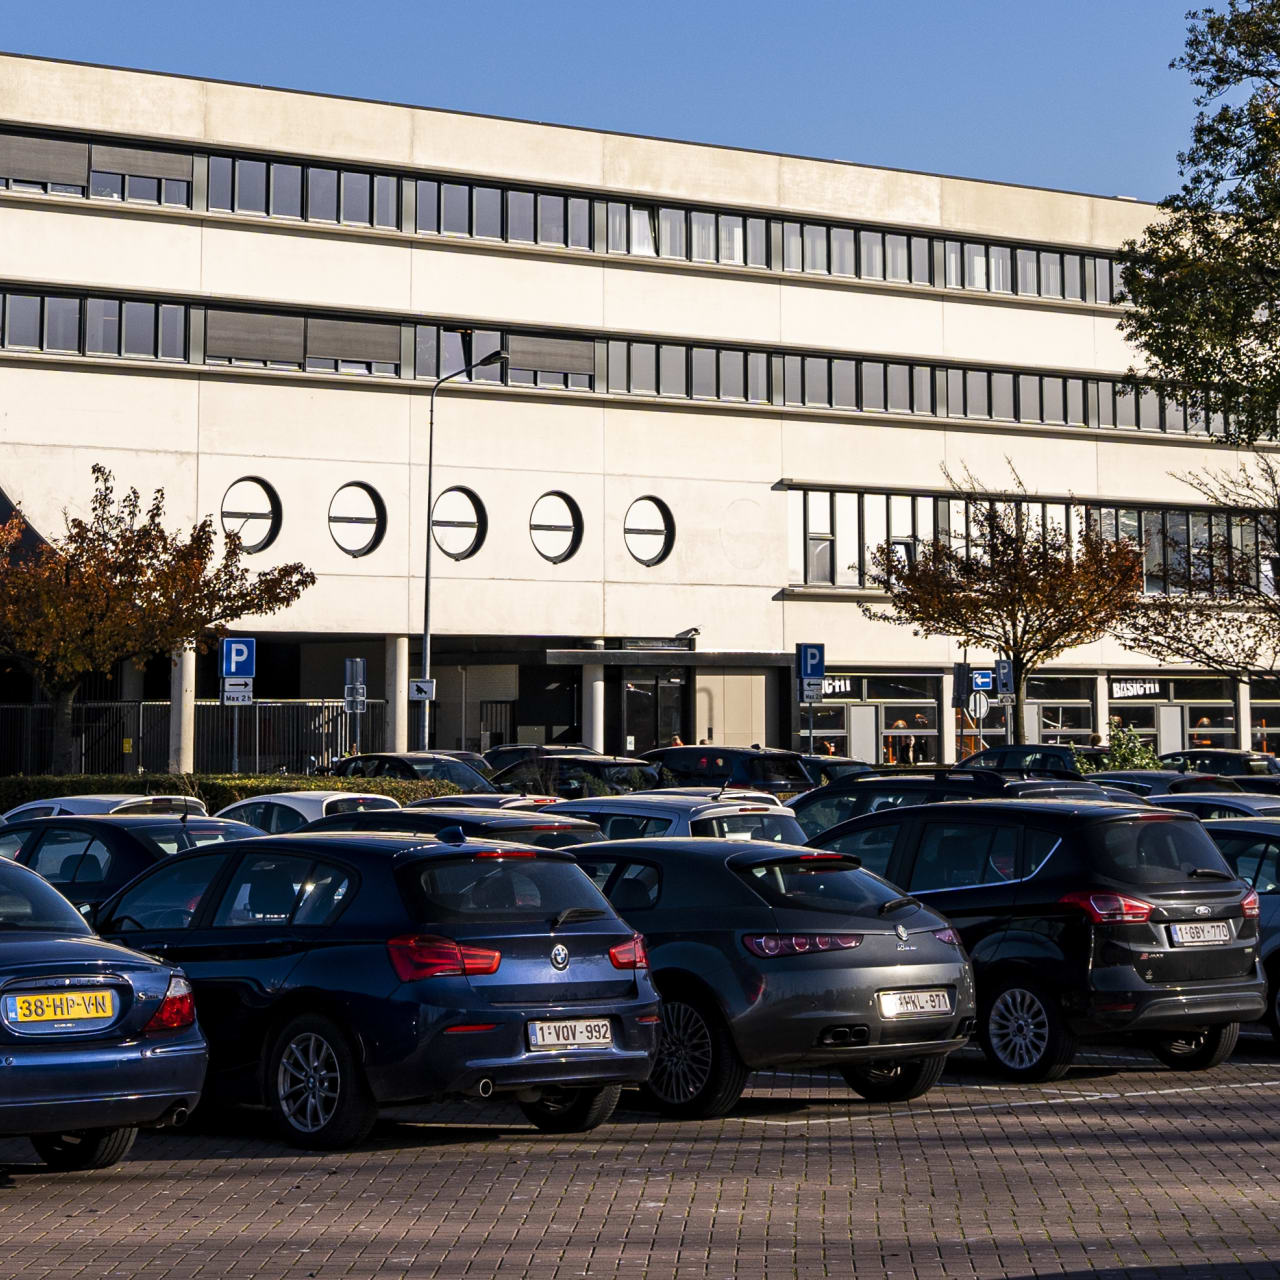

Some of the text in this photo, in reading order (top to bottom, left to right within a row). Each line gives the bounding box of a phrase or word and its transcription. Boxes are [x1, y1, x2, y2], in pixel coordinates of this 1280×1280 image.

[231, 643, 249, 672] P
[807, 648, 820, 674] P
[1000, 662, 1009, 680] P
[1178, 923, 1228, 940] 1-GBY-770
[22, 994, 107, 1018] 38-HP-VN
[898, 992, 949, 1011] -HKL-971
